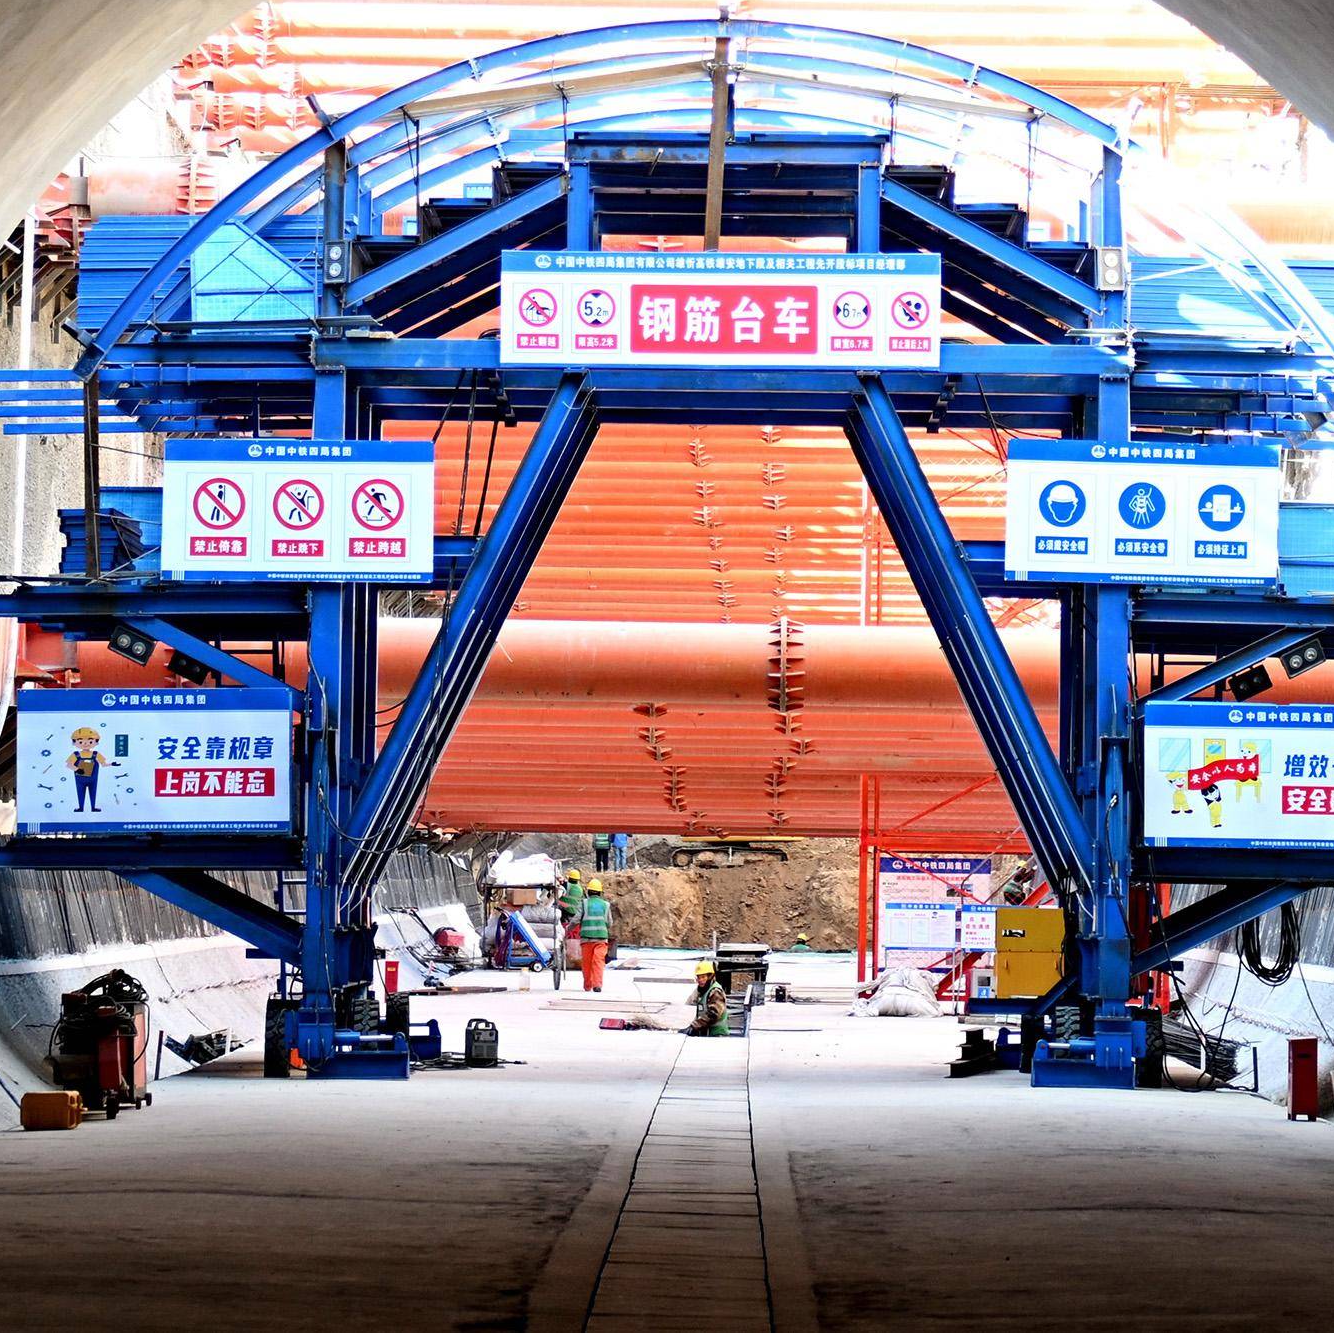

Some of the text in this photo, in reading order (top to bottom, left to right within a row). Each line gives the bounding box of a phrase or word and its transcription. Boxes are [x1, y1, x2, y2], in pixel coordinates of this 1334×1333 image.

[584, 301, 609, 316] 5.2m
[638, 296, 810, 344] 钢筋台车
[578, 337, 614, 347] 限高5.2米
[834, 339, 870, 349] 限宽6.7米
[265, 445, 352, 457] 中国中铁四局集团
[1108, 447, 1196, 460] 中国中铁四局集团
[194, 539, 242, 554] 禁止倚靠
[277, 543, 319, 555] 禁止跳下
[353, 541, 402, 555] 禁止跨越
[1037, 540, 1085, 553] 必须戴安全帽
[1117, 542, 1165, 555] 必须系安全带
[1197, 544, 1245, 557] 必须持证上岗
[118, 695, 206, 705] 中国中铁四局集团
[1245, 712, 1333, 723] 中国中铁四局集团
[157, 736, 274, 760] 安全靠规章
[159, 771, 266, 795] 上岗不能忘
